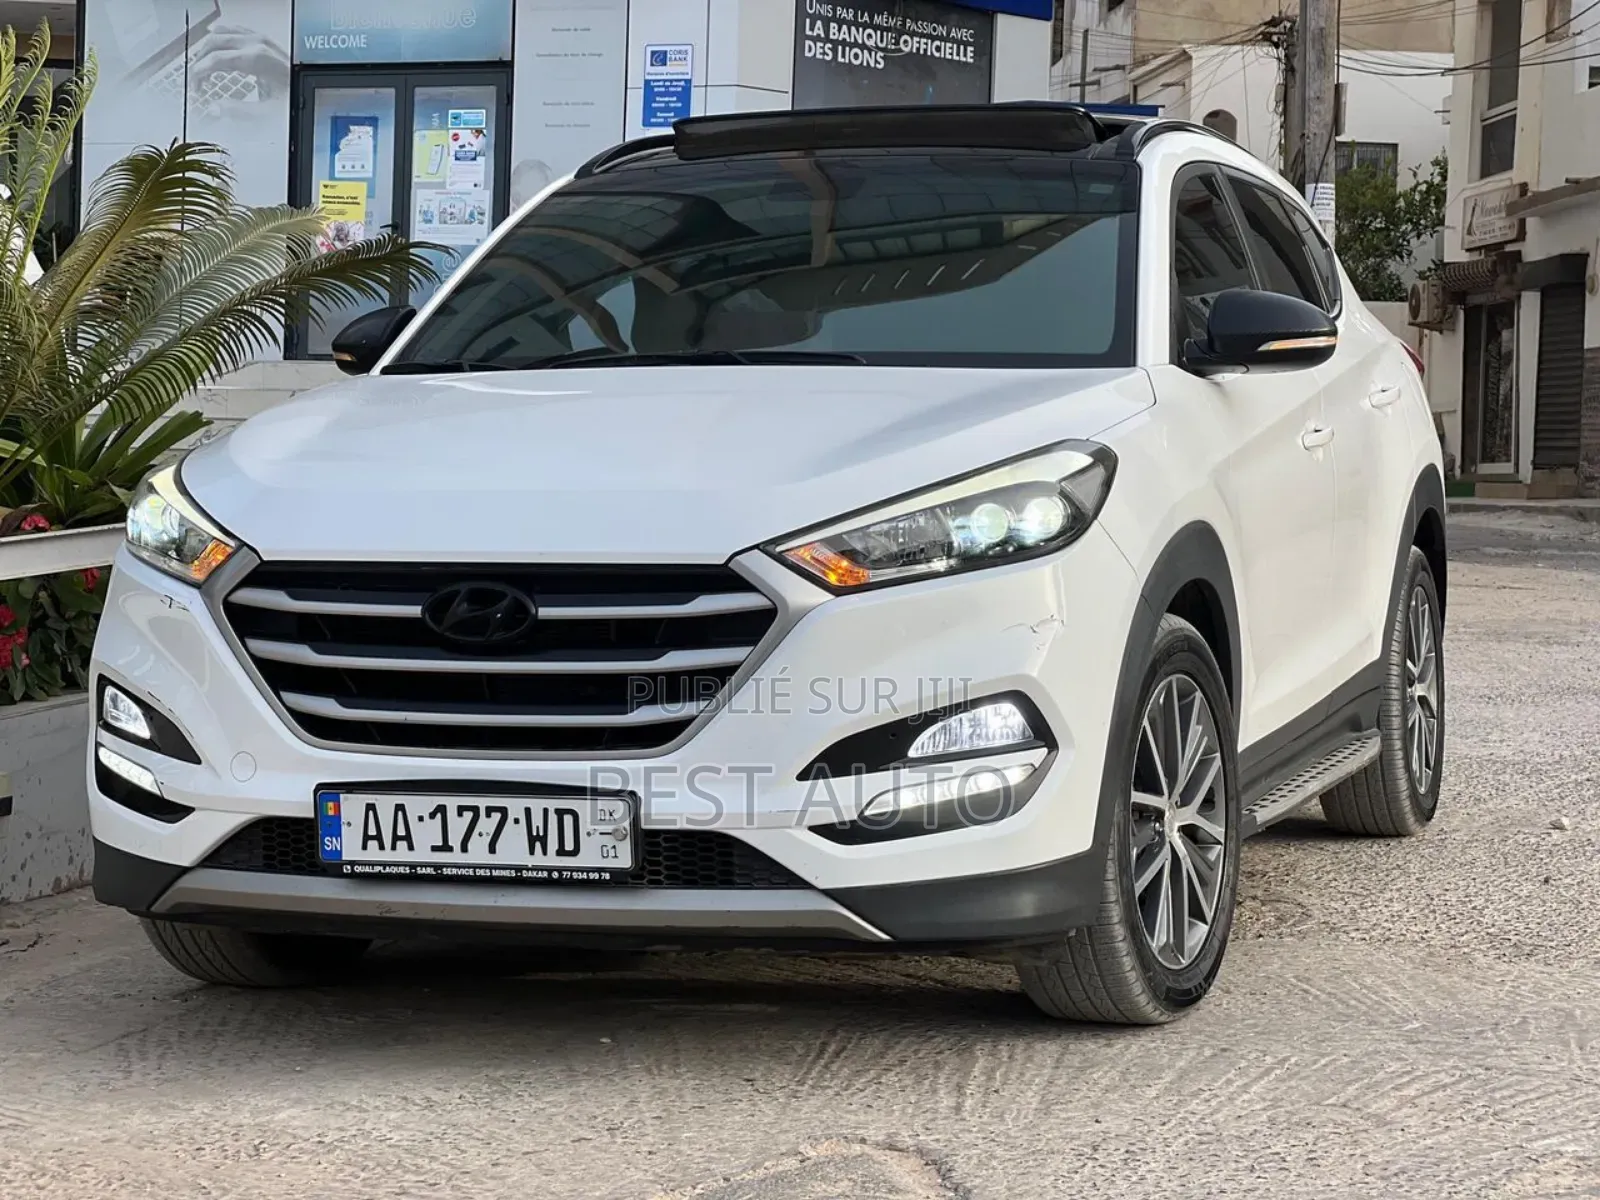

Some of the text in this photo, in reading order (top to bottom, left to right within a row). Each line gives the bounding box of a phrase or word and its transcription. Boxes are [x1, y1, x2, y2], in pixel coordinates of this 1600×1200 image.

[837, 8, 854, 20] PAR
[858, 10, 870, 24] LA
[873, 12, 903, 27] MÊME
[906, 18, 947, 37] PASSION
[950, 28, 975, 42] AVEC
[304, 34, 368, 49] WELCOME
[805, 18, 975, 63] LA BANQUE OFFICIELLE
[805, 40, 885, 70] DES LIONS
[324, 836, 341, 850] SN
[353, 865, 410, 874] QUALIPLAQUES
[416, 866, 437, 874] SARL
[442, 867, 474, 875] SERVICE
[475, 868, 490, 876] DES
[492, 869, 516, 877] MINES
[522, 870, 548, 878] DAKAR
[562, 871, 571, 879] 77
[571, 871, 587, 879] 934
